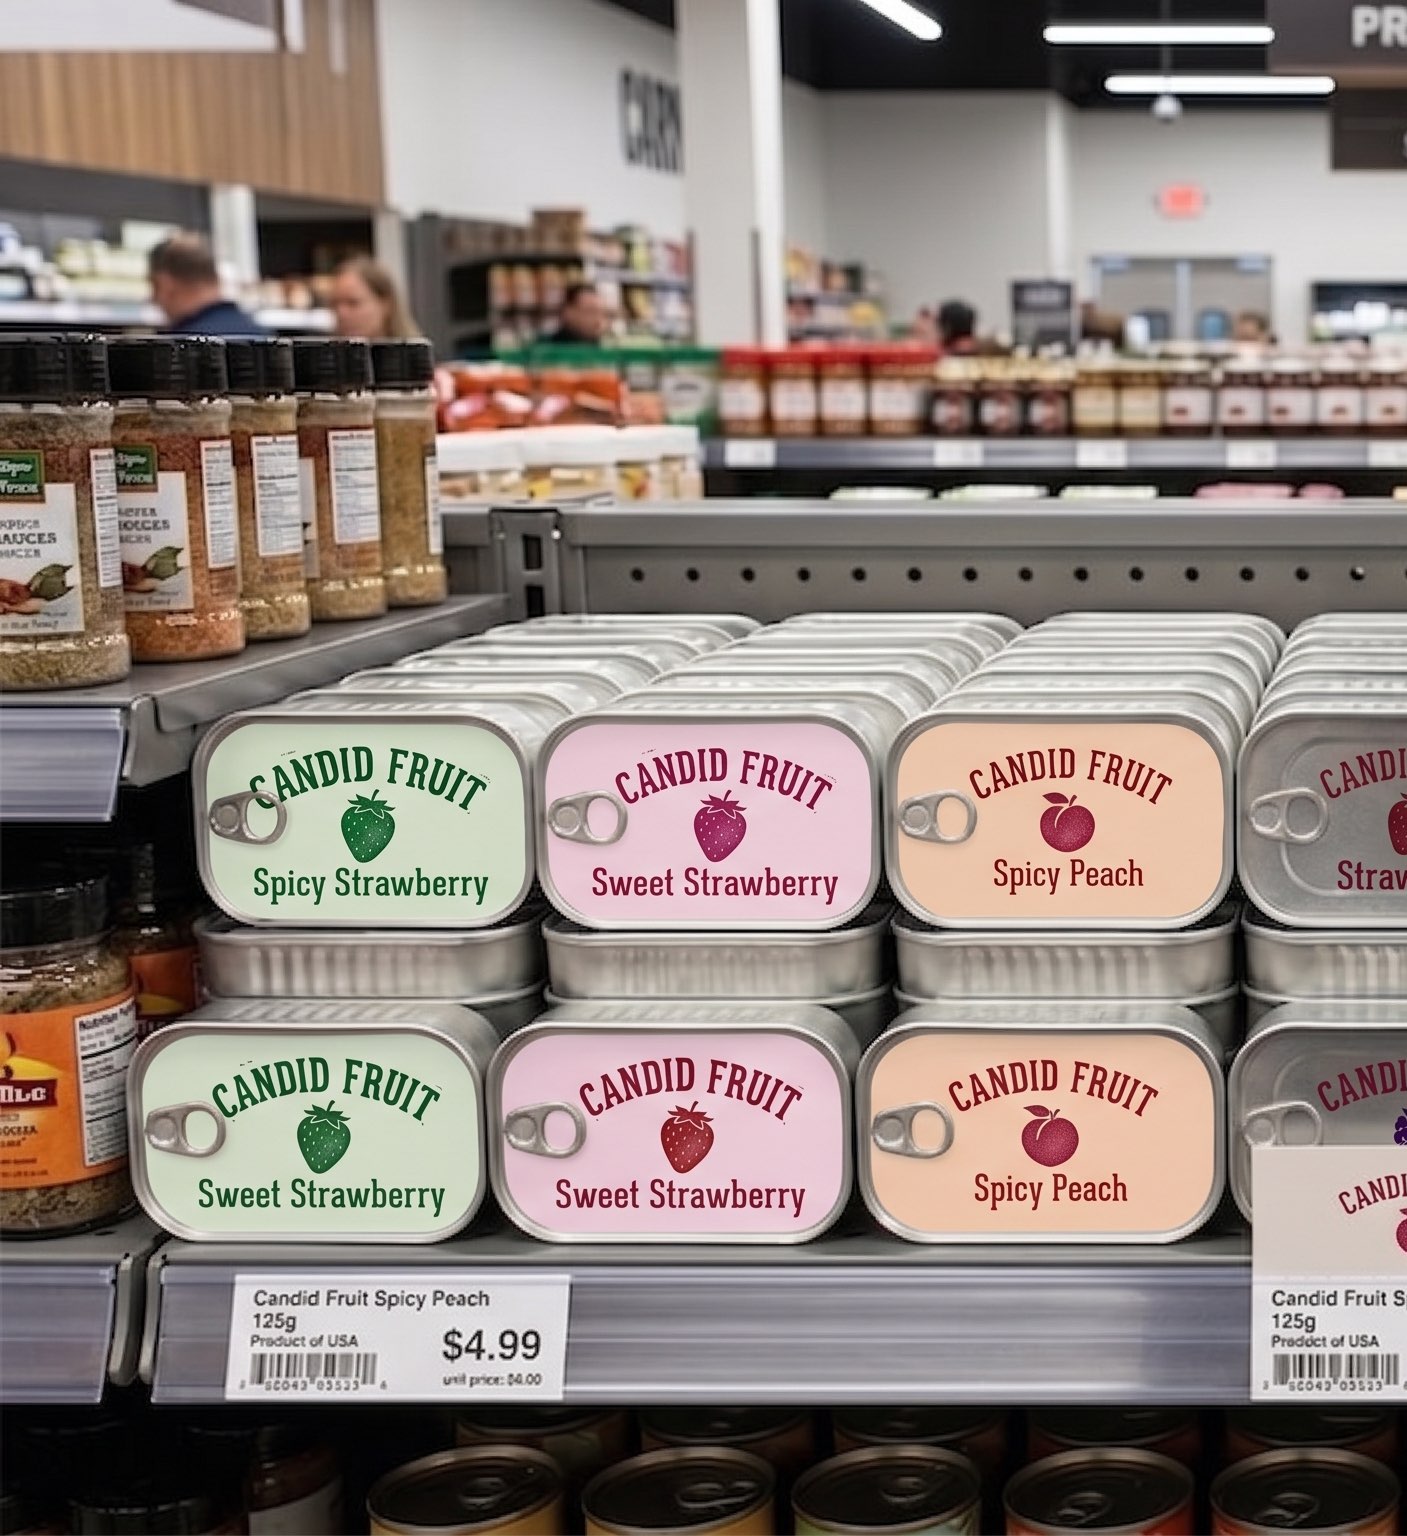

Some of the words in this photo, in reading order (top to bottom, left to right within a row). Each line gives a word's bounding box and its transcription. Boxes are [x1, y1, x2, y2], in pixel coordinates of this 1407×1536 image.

[249, 746, 374, 810] CANDID
[387, 748, 487, 810] FRUIT
[616, 746, 728, 806] CANDID
[740, 750, 832, 810] FRUIT
[969, 748, 1076, 800] CANDID
[1087, 750, 1172, 804] FRUIT
[254, 868, 326, 905] Spicy
[335, 868, 488, 905] Strawberry
[592, 867, 673, 896] Sweet
[684, 867, 838, 905] Strawberry
[994, 859, 1060, 895] Spicy
[1070, 859, 1143, 886] Peach
[212, 1057, 330, 1119] CANDID
[343, 1059, 440, 1121] FRUIT
[579, 1057, 695, 1116] CANDID
[707, 1059, 802, 1120] FRUIT
[948, 1060, 1058, 1111] CANDID
[1071, 1061, 1158, 1116] FRUIT
[199, 1179, 281, 1208] Sweet
[291, 1178, 445, 1217] Strawberry
[556, 1179, 639, 1208] Sweet
[650, 1179, 805, 1218] Strawberry
[975, 1173, 1043, 1210] Spicy
[1053, 1173, 1127, 1201] Peach
[254, 1290, 320, 1306] Candid
[326, 1289, 368, 1306] Fruit
[375, 1290, 427, 1311] Spicy
[433, 1290, 489, 1306] Peach
[1272, 1290, 1337, 1306] Candid
[1345, 1290, 1387, 1306] Fruit
[254, 1312, 296, 1333] 125g
[309, 1335, 324, 1347] of
[328, 1334, 358, 1347] USA
[1272, 1313, 1316, 1333] 125g
[443, 1328, 541, 1363] $4.99
[1331, 1335, 1344, 1348] of
[1349, 1335, 1379, 1347] USA
